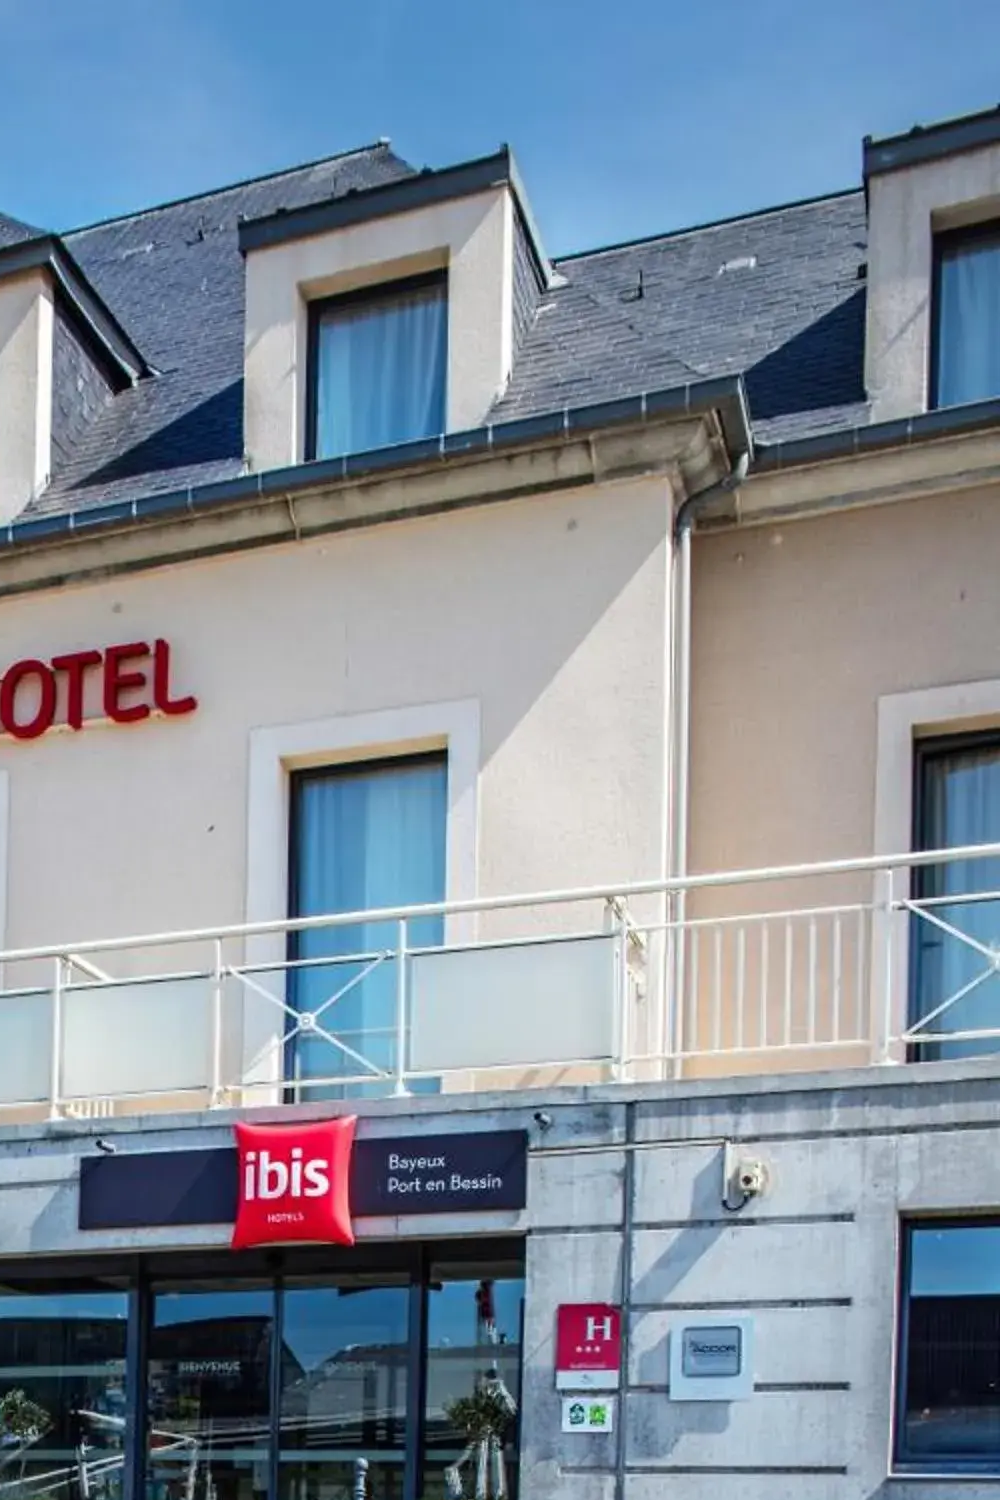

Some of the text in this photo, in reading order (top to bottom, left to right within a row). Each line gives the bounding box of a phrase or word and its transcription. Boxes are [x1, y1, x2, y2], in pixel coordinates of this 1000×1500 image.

[245, 1148, 330, 1200] ibis
[388, 1154, 446, 1174] Bayeux
[388, 1173, 502, 1194] Port en Bessin
[266, 1211, 305, 1224] HOTELS
[586, 1316, 612, 1341] H
